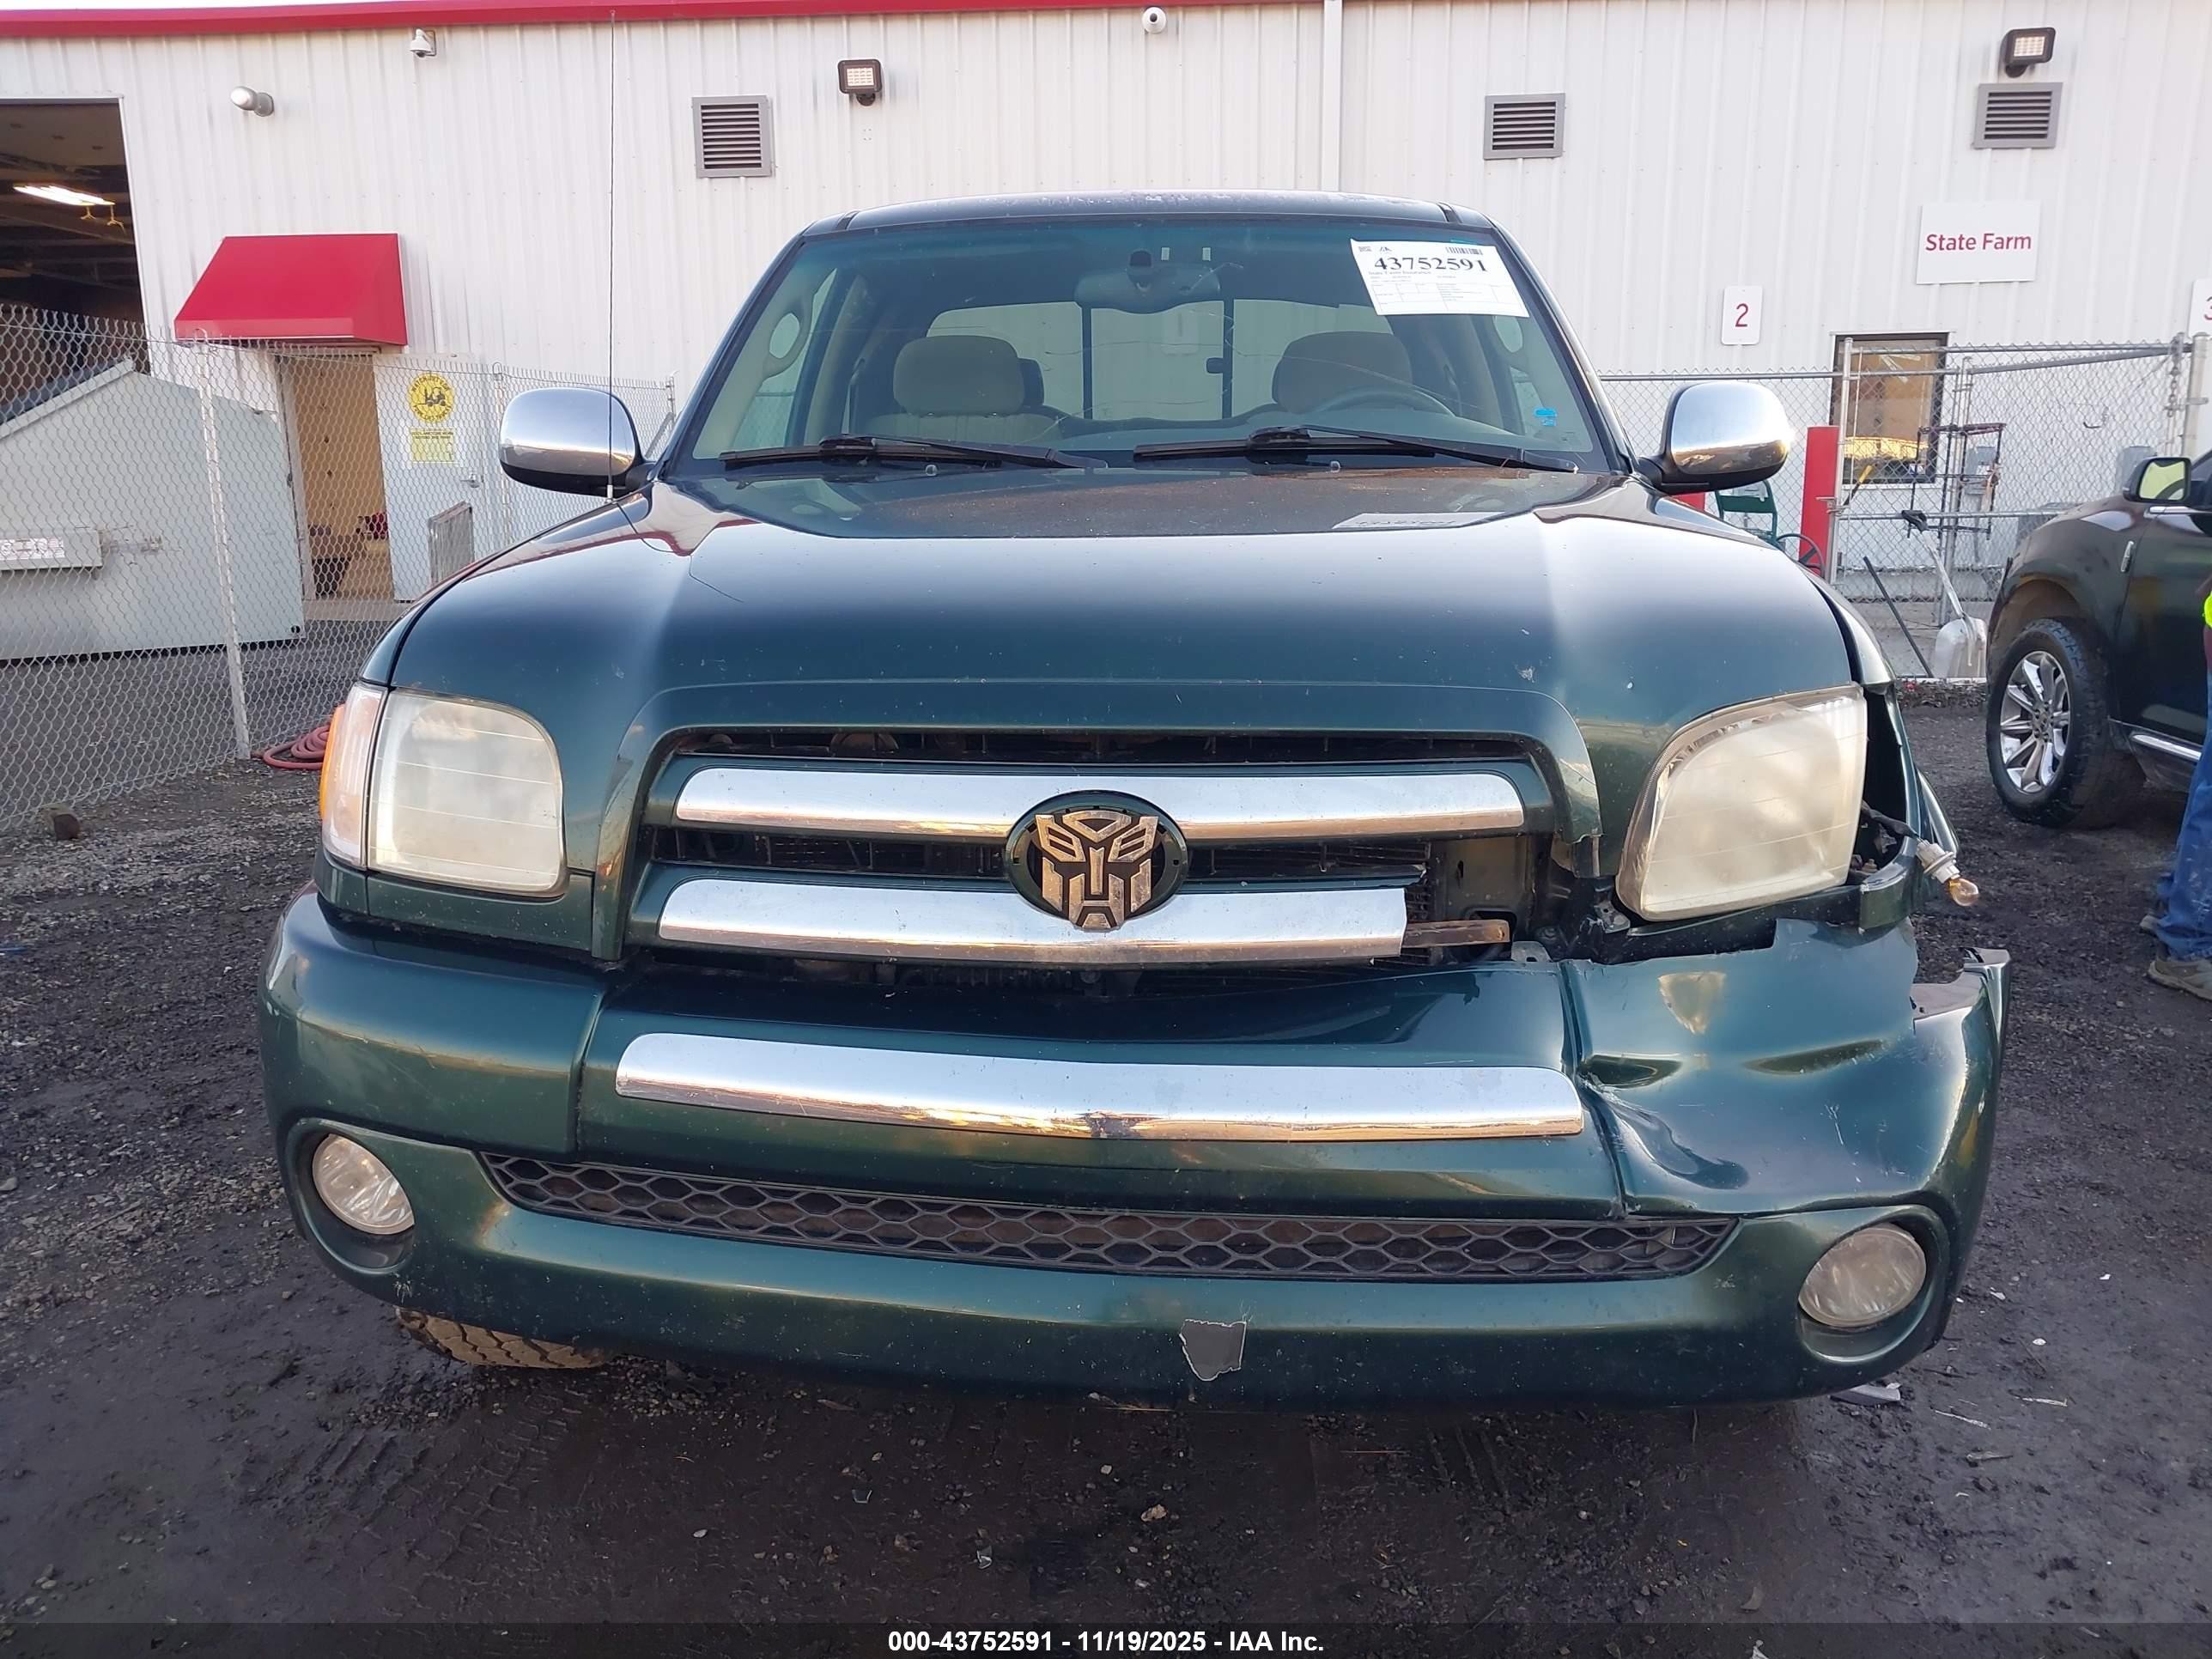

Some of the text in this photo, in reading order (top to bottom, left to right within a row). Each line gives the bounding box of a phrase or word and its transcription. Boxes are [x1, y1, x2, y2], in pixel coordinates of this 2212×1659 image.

[1925, 232, 2032, 251] State Farm
[1374, 256, 1488, 272] 43752591
[1735, 302, 1749, 328] 2
